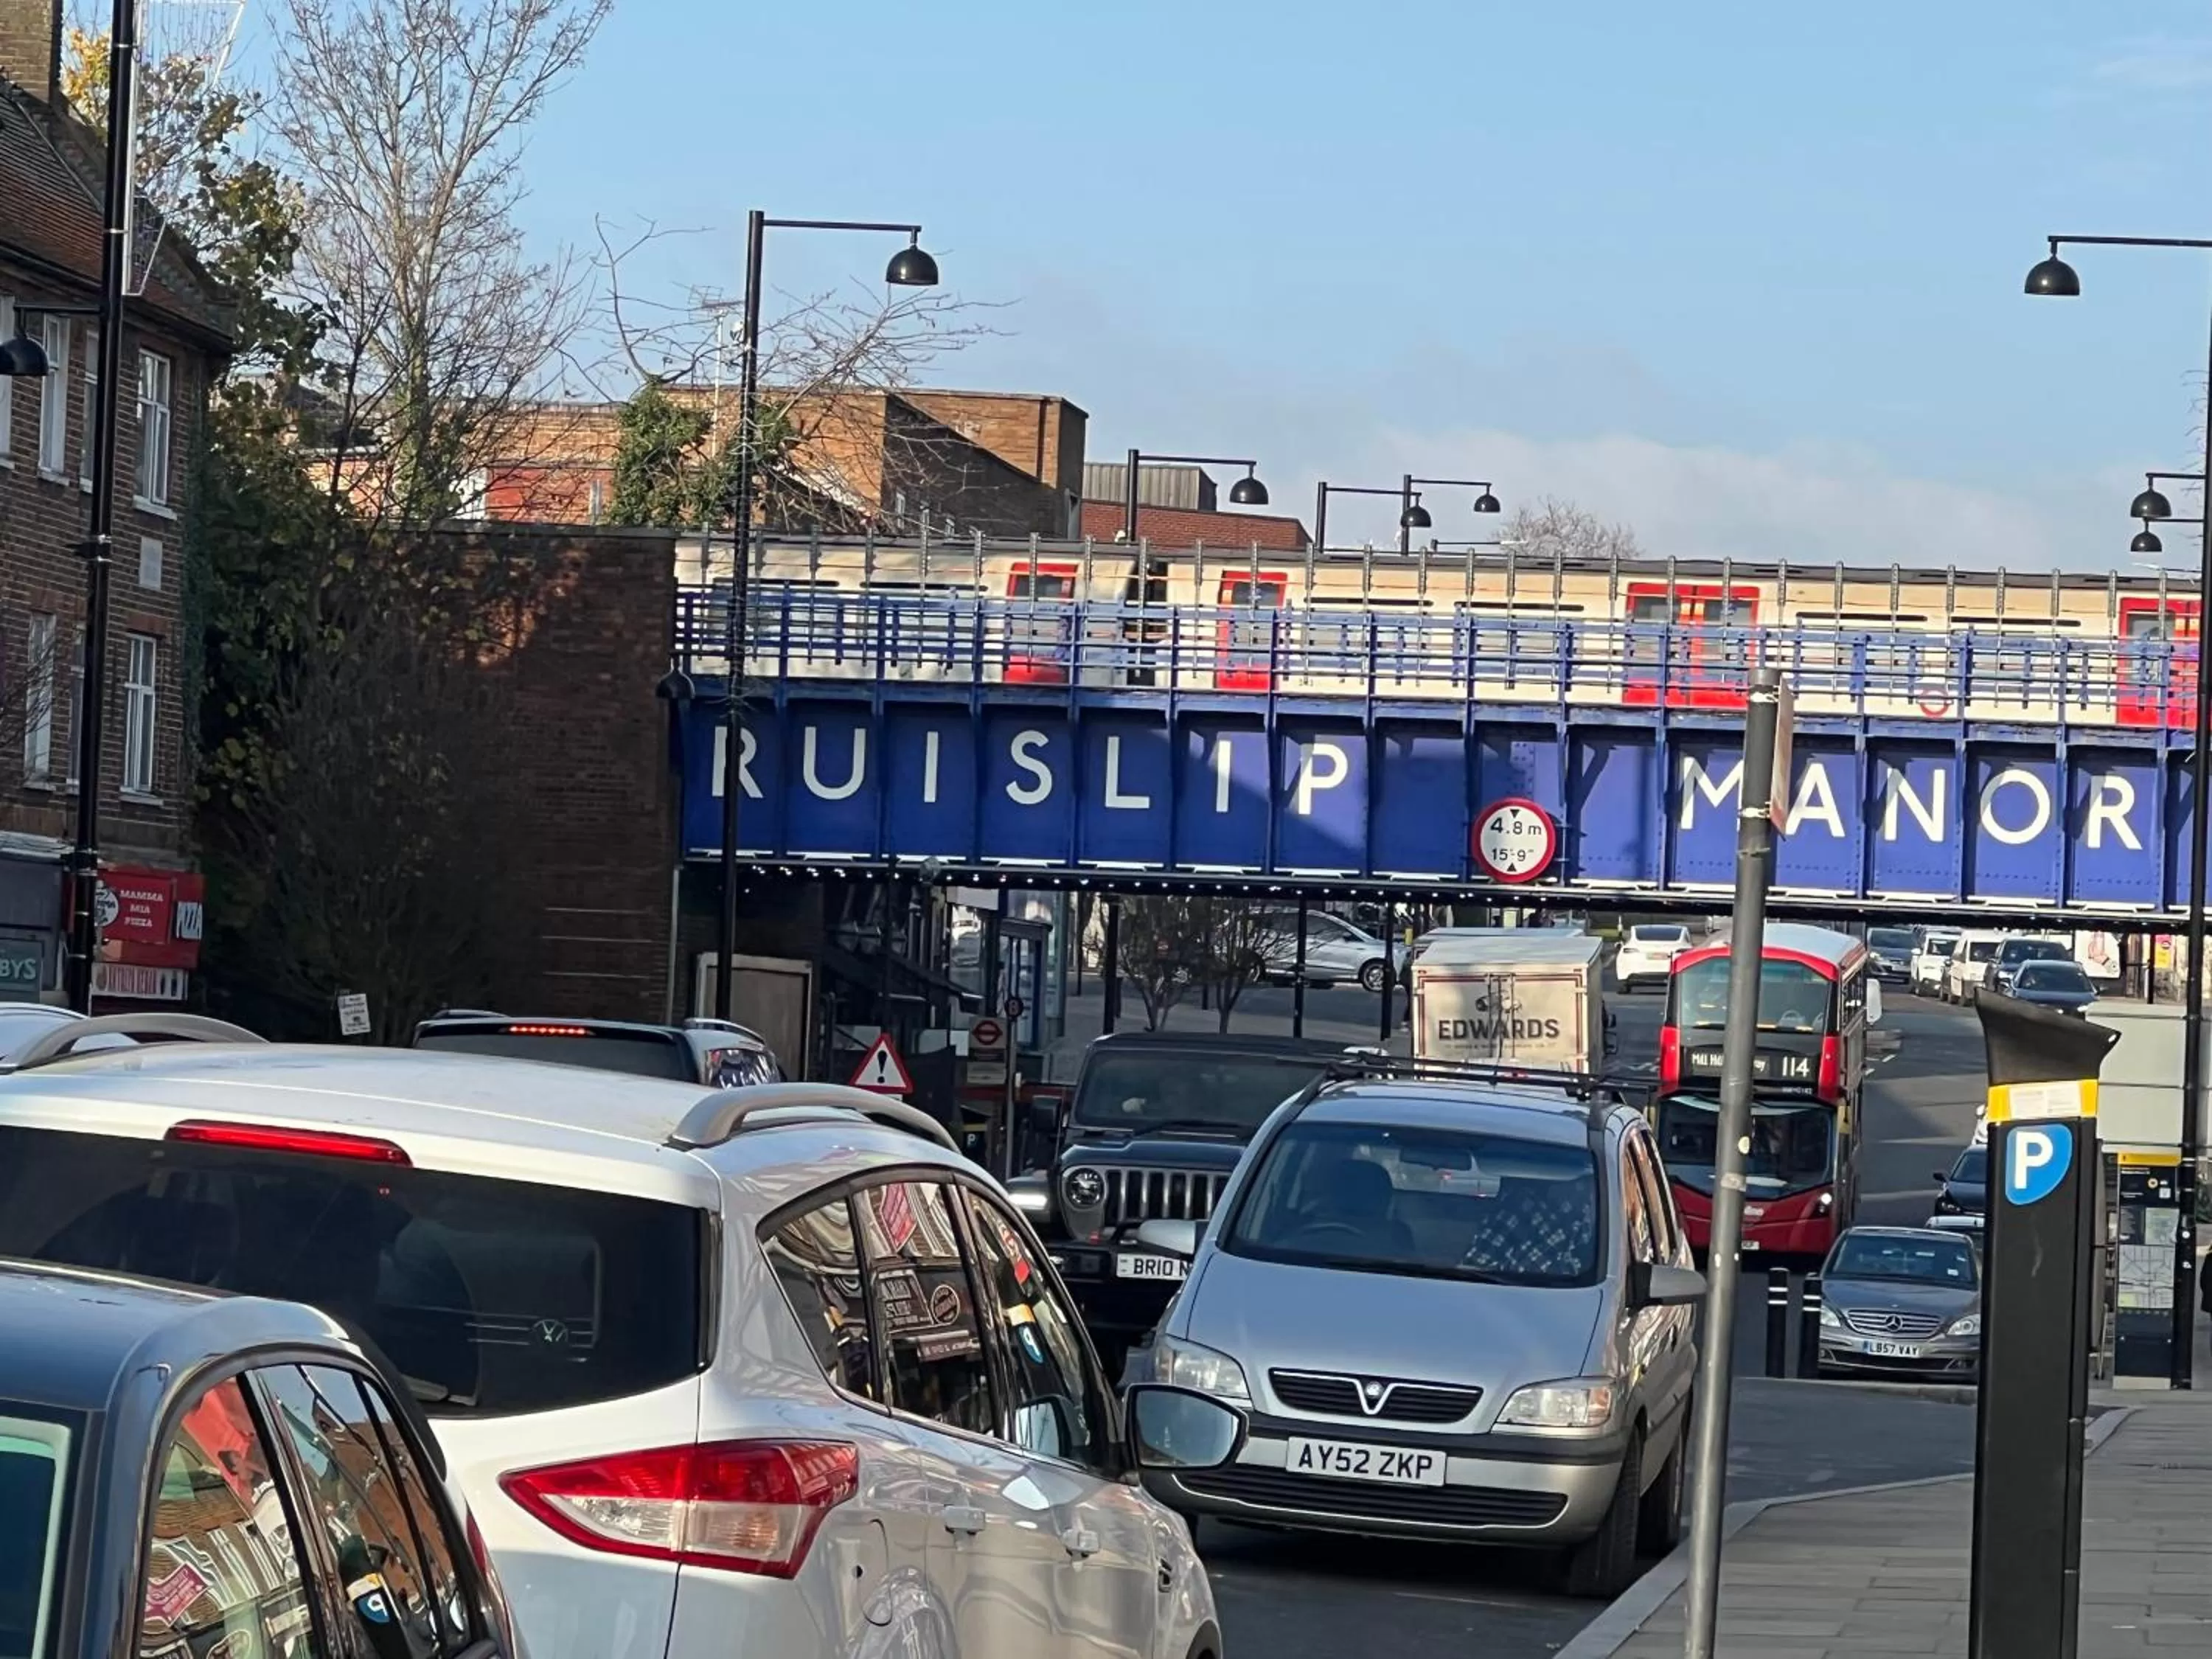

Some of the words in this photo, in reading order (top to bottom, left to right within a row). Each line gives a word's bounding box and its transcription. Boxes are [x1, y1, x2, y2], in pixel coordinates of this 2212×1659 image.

[712, 726, 1349, 815] RUISLIP
[1681, 757, 2143, 849] MANOR
[1490, 817, 1523, 835] 4.8
[1528, 825, 1542, 835] m
[119, 889, 164, 902] MAMMA
[130, 904, 150, 914] MIA
[124, 917, 153, 928] PIZZA
[1439, 1019, 1560, 1040] EDWARDS
[1782, 1056, 1809, 1077] 114
[2014, 1131, 2053, 1189] P
[1298, 1444, 1370, 1474] AY52
[1378, 1451, 1432, 1479] ZKP
